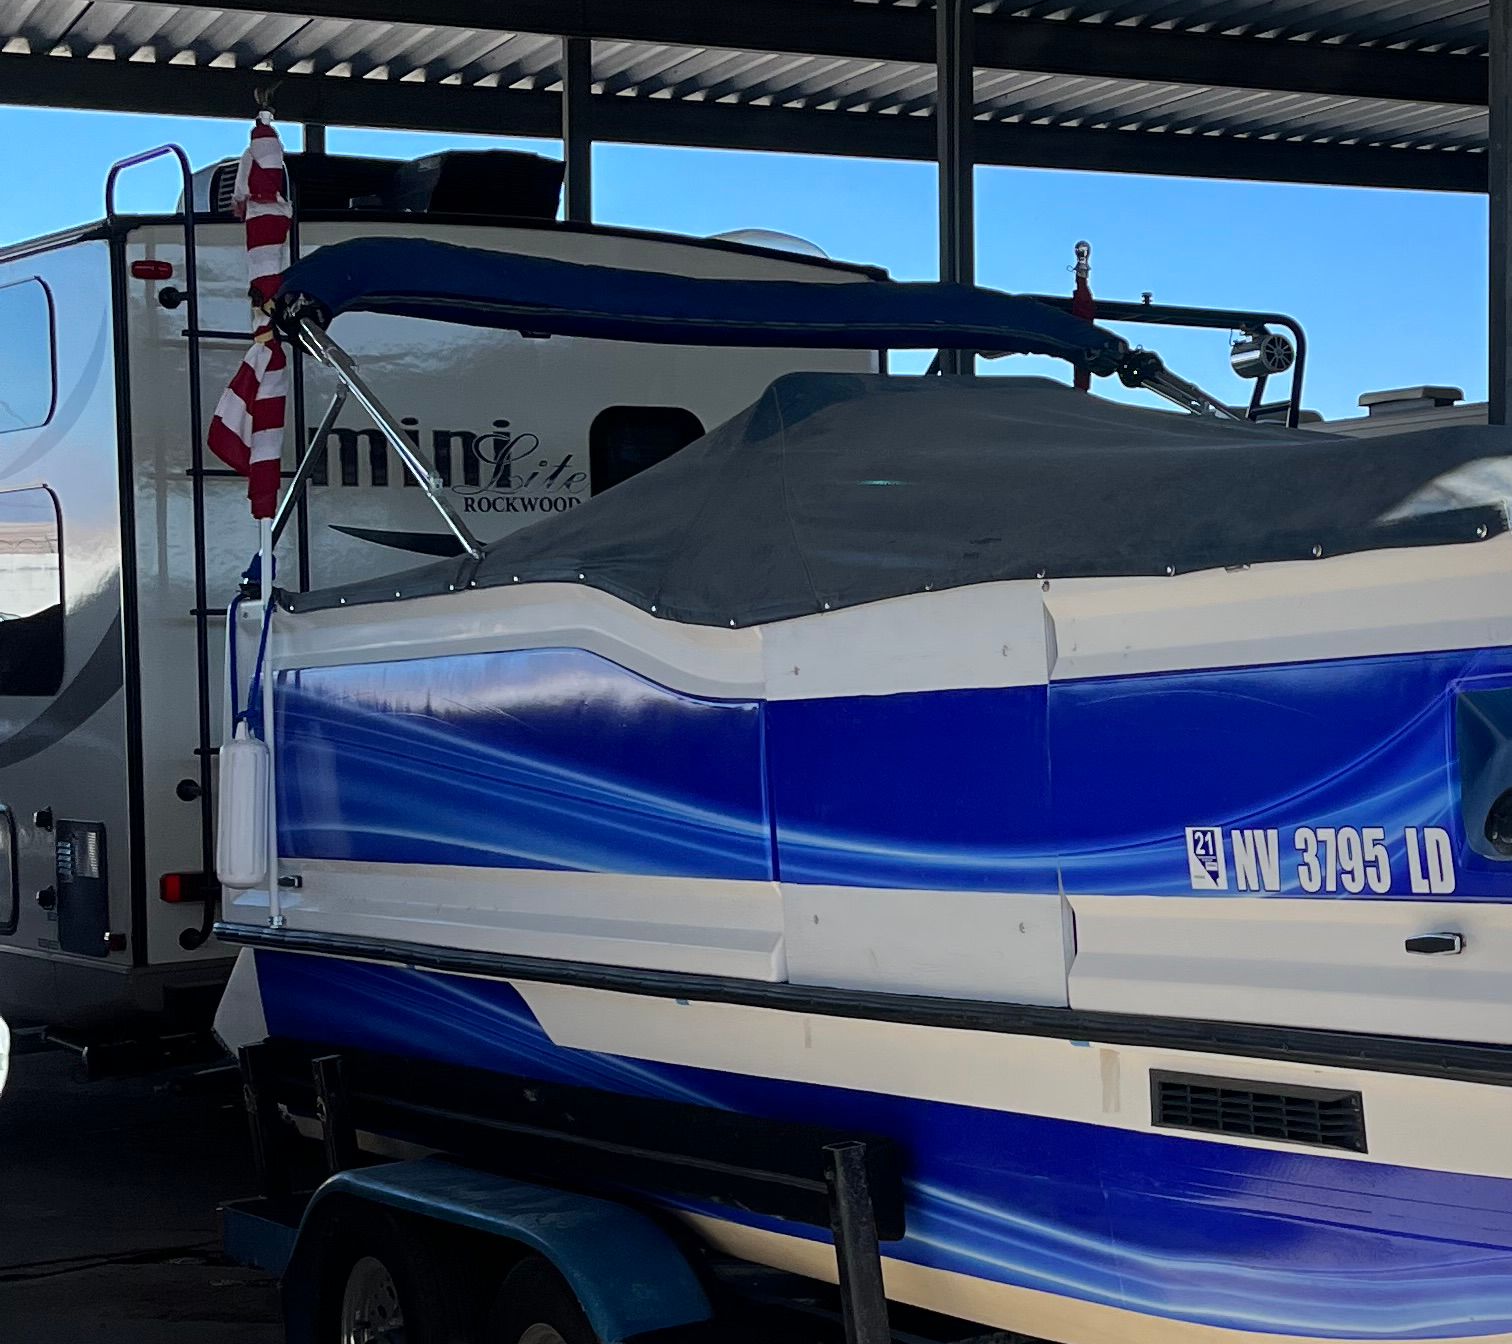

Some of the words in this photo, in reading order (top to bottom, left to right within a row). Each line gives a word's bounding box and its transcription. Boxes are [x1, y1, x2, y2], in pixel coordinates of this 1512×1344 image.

[308, 417, 511, 488] mini
[452, 433, 590, 494] Lite
[1194, 831, 1214, 855] 21
[1231, 828, 1281, 892] NV
[1295, 826, 1392, 894] 3795
[1404, 826, 1456, 894] LD
